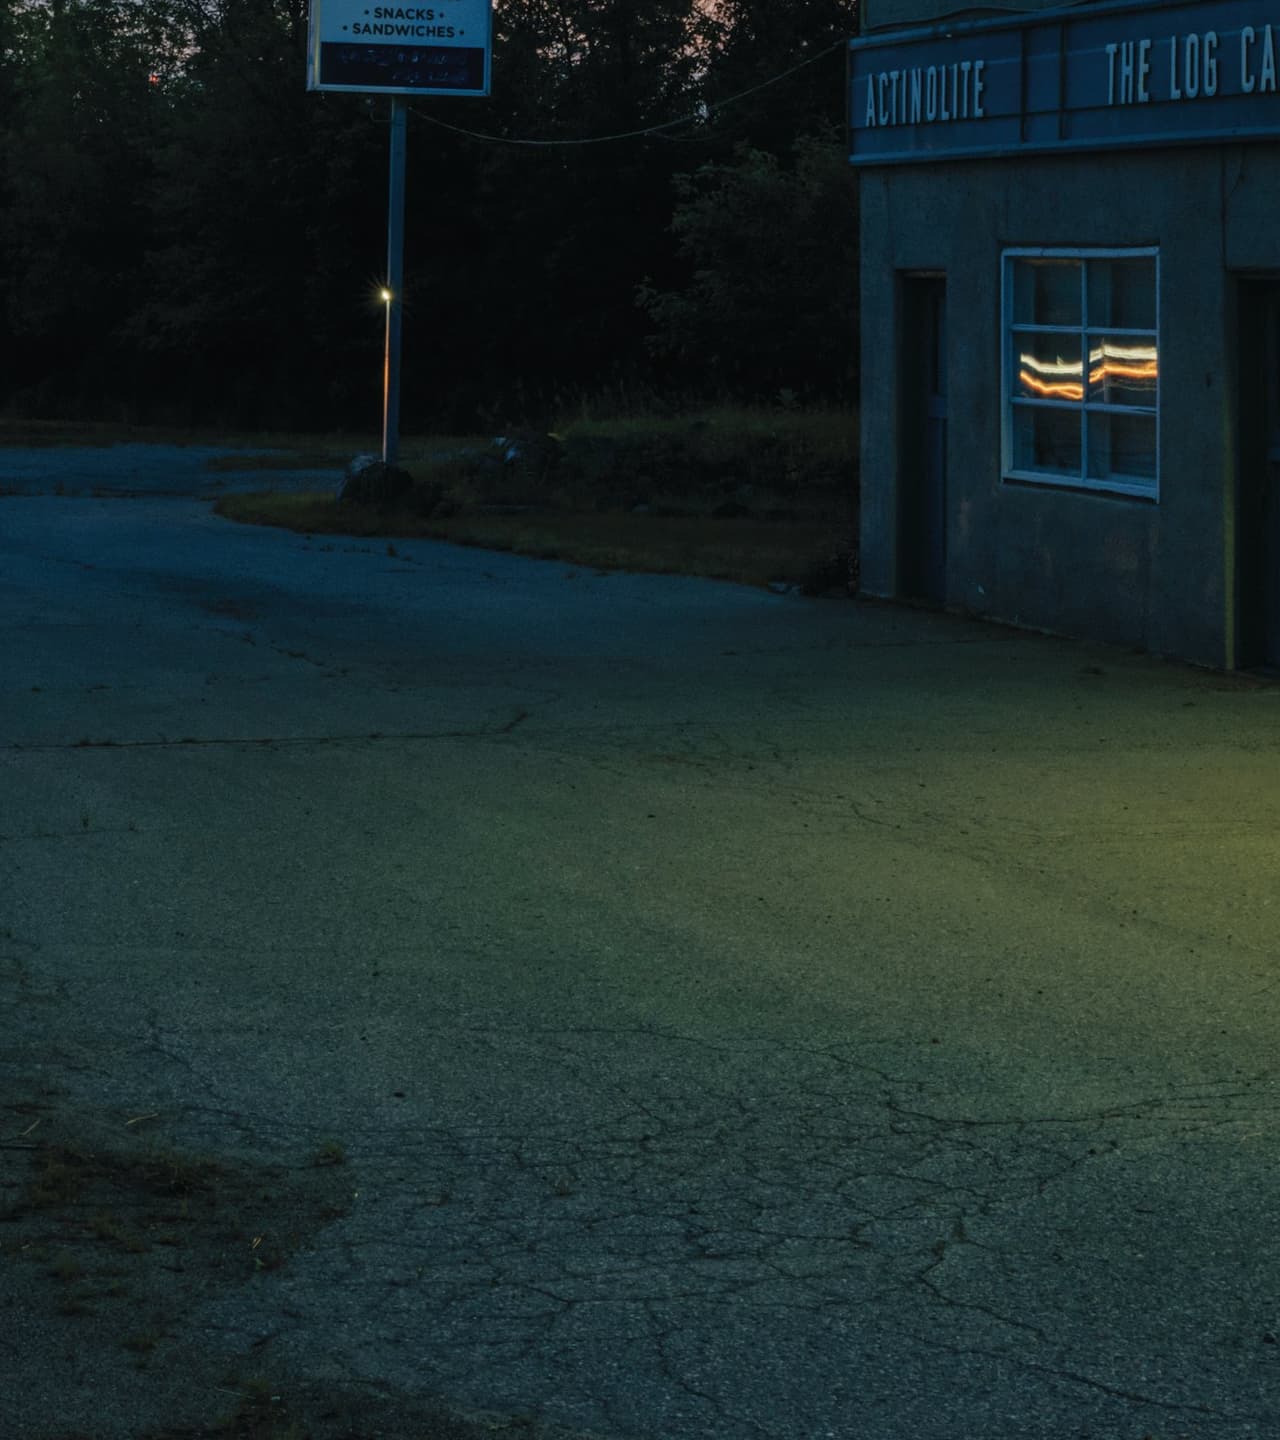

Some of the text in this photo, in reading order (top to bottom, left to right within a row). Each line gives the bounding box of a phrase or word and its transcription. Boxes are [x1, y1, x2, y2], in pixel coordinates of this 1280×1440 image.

[352, 23, 455, 37] SANDWICHES
[374, 8, 434, 20] SNACKS
[1106, 39, 1151, 105] THE
[1171, 31, 1218, 100] LOG
[865, 60, 985, 127] ACTINOLITE
